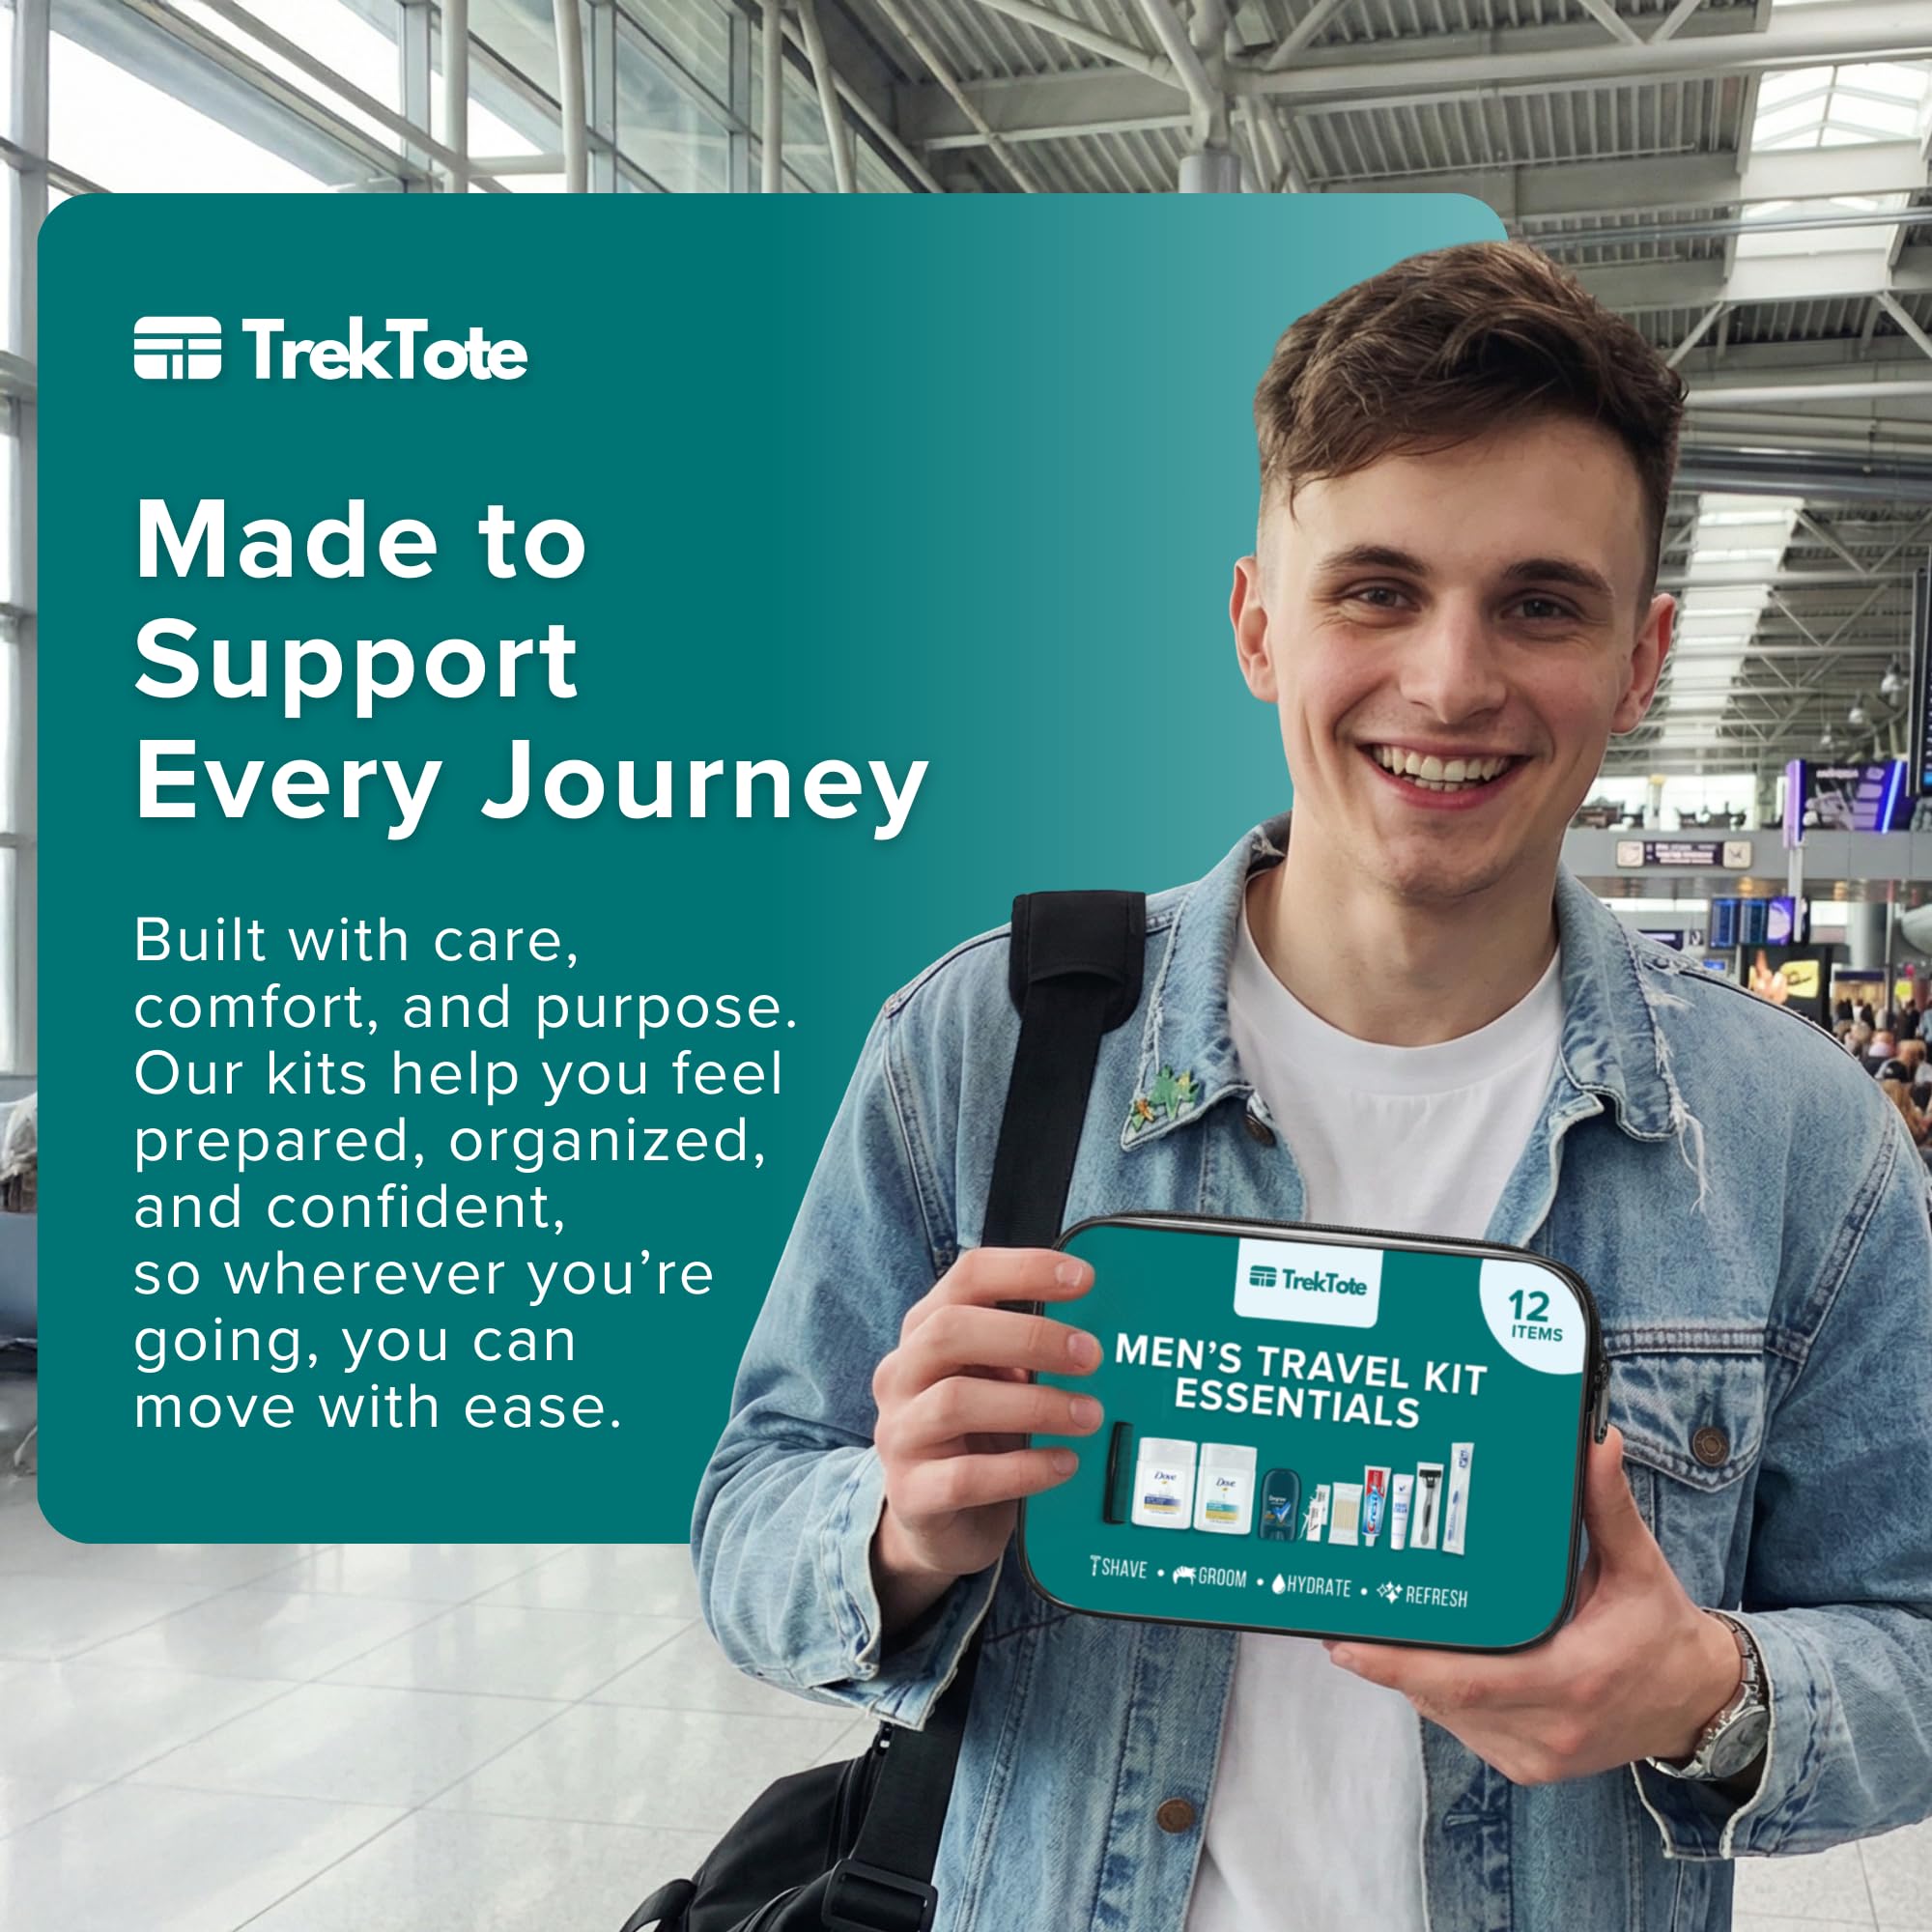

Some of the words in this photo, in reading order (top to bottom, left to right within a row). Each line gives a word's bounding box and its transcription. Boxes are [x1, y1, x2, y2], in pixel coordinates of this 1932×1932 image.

[1283, 1268, 1368, 1296] TrekTote
[1509, 1289, 1550, 1322] 12
[1512, 1324, 1563, 1342] ITEMS
[1115, 1332, 1242, 1374] MEN’S
[1257, 1346, 1409, 1389] TRAVEL
[1424, 1360, 1488, 1396] KIT
[1175, 1377, 1420, 1429] ESSENTIALS
[1154, 1470, 1177, 1481] Dove
[1216, 1477, 1236, 1488] Dove
[1101, 1557, 1148, 1579] SHAVE
[1198, 1567, 1247, 1588] GROOM
[1288, 1575, 1351, 1598] HYDRATE
[1406, 1585, 1468, 1608] REFRESH
